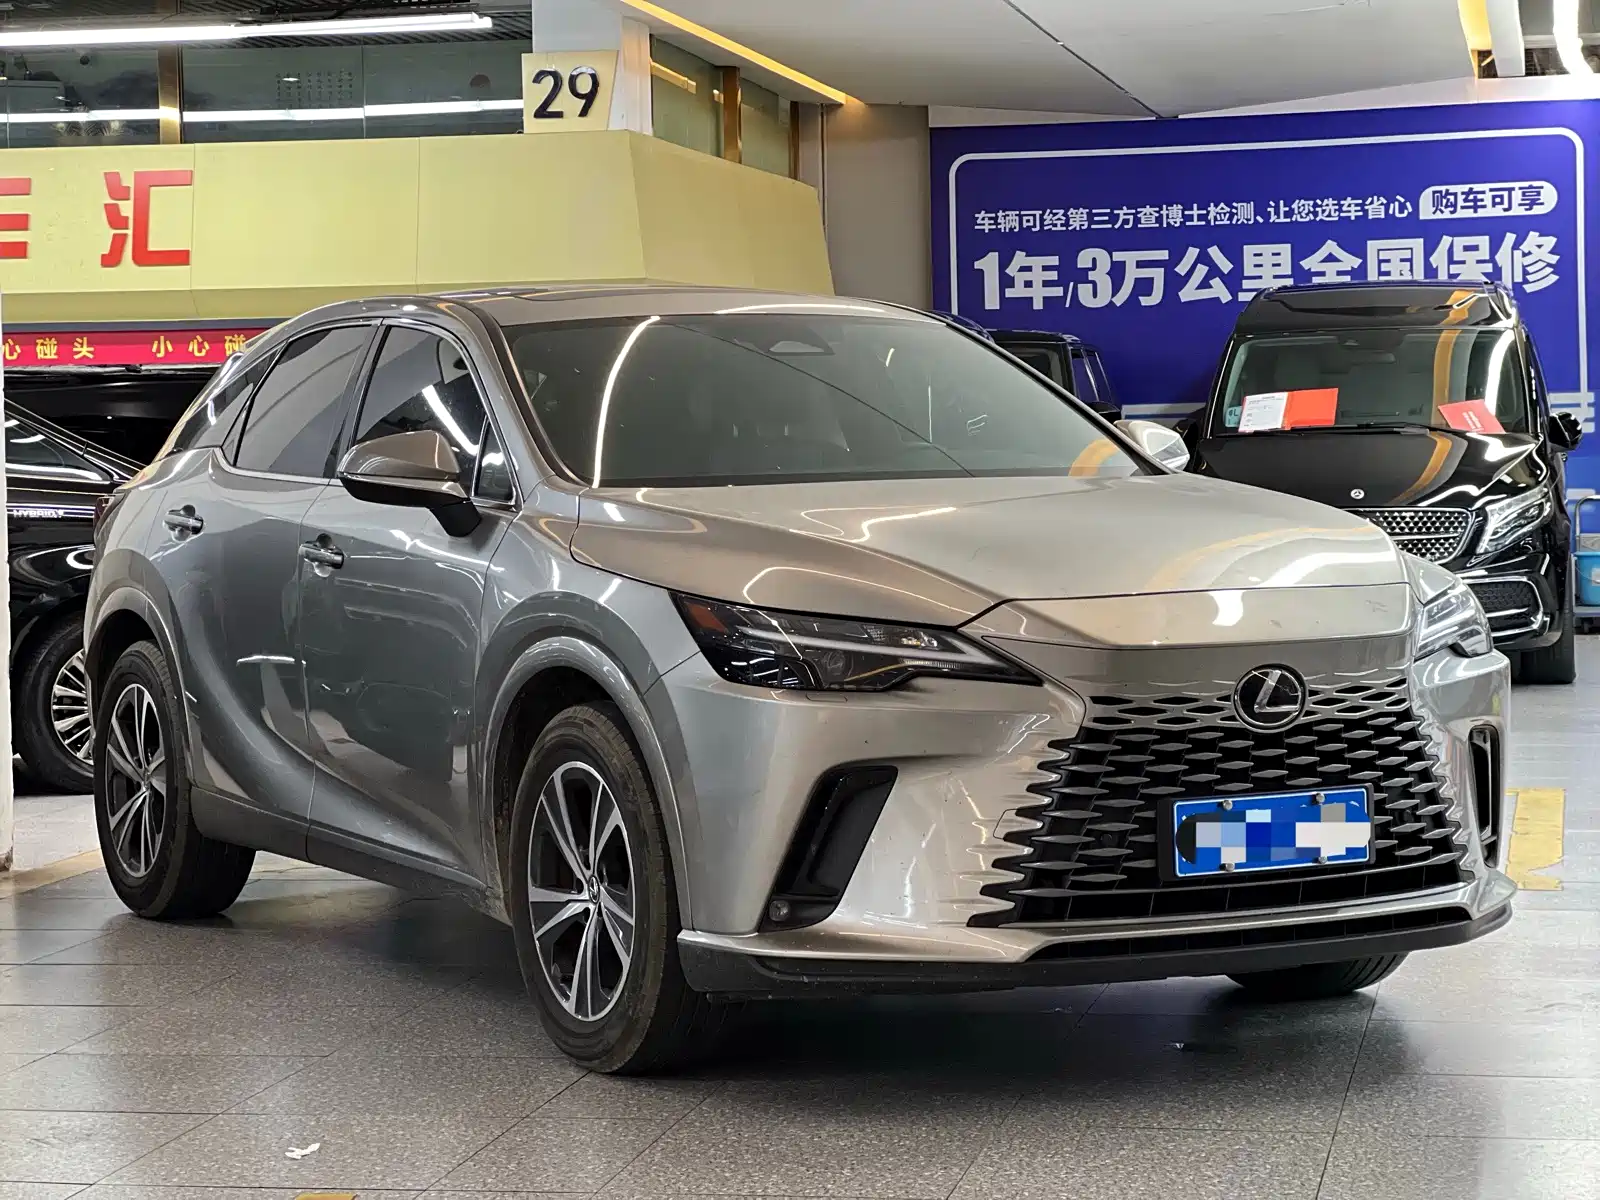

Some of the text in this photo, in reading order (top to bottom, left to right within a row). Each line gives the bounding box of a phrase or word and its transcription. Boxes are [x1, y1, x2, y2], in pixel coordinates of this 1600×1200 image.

[532, 65, 600, 119] 29
[1431, 184, 1545, 215] 购车可享
